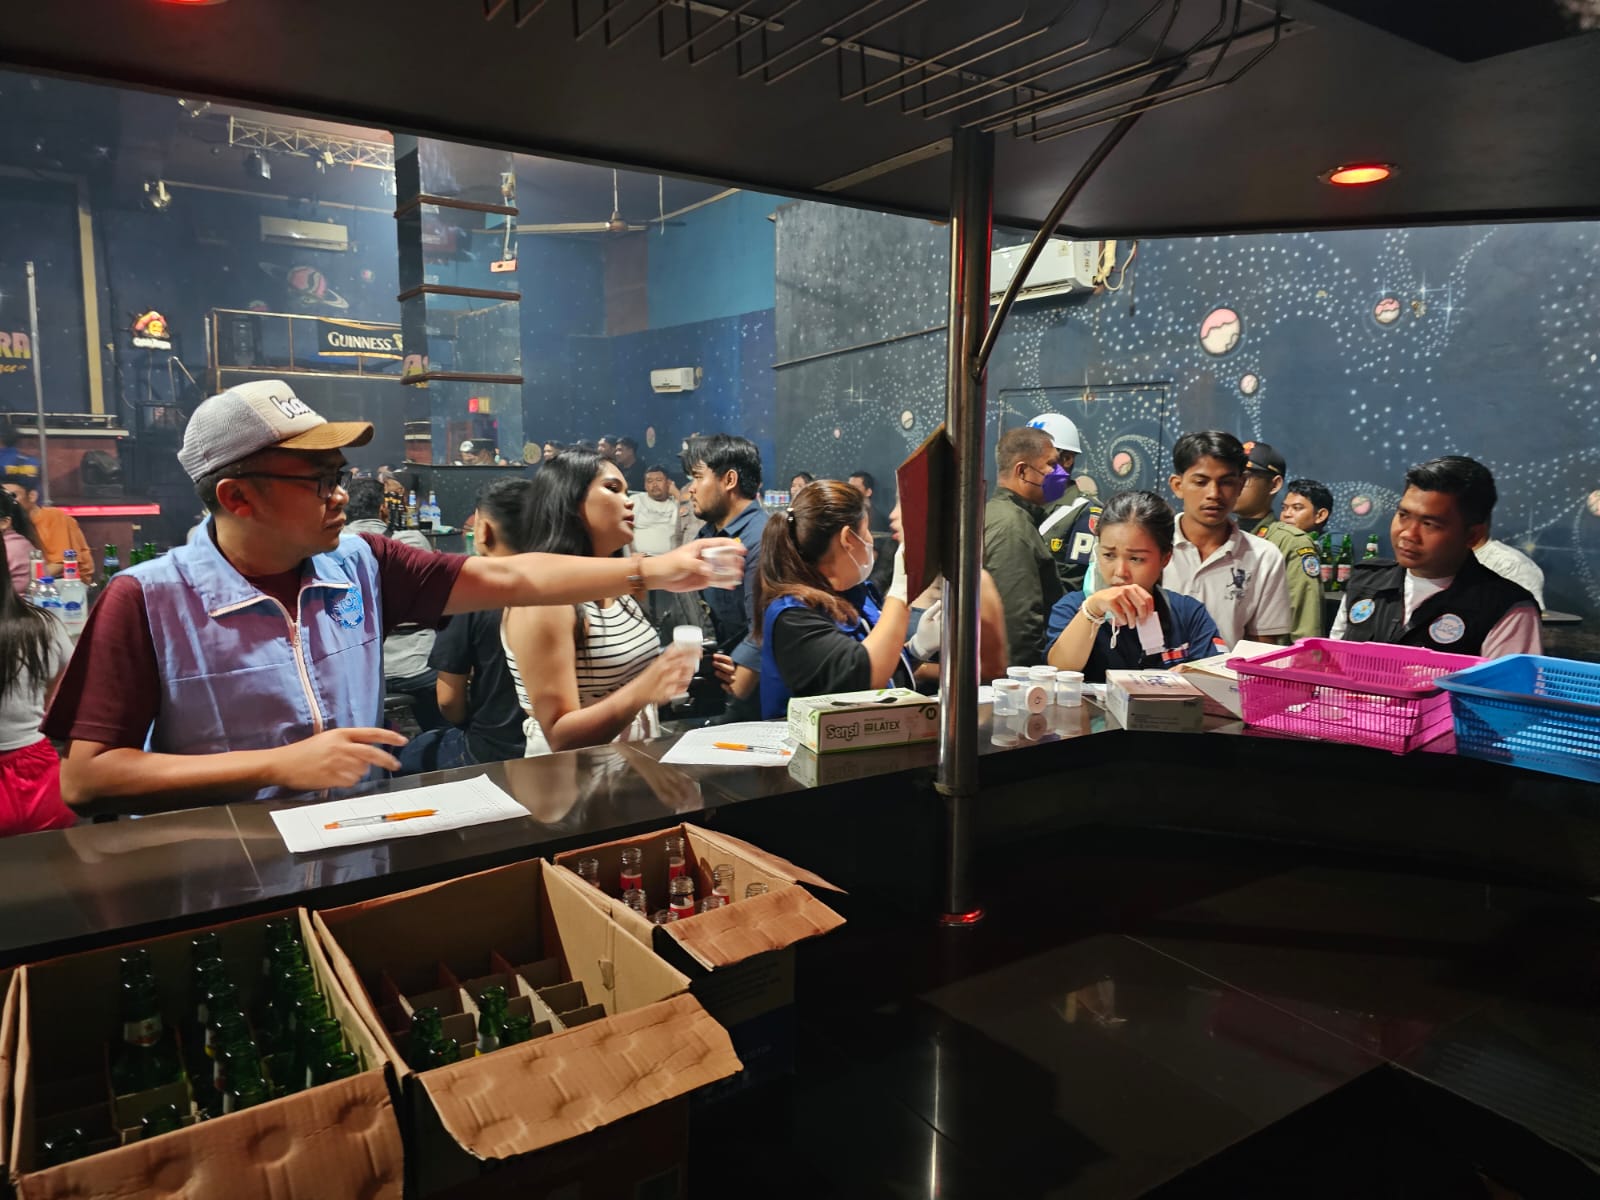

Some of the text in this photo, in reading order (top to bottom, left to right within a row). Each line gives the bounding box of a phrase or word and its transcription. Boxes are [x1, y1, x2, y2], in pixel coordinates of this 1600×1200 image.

[327, 331, 393, 351] GUINNESS
[826, 722, 860, 742] Sensi
[874, 720, 900, 732] LATEX
